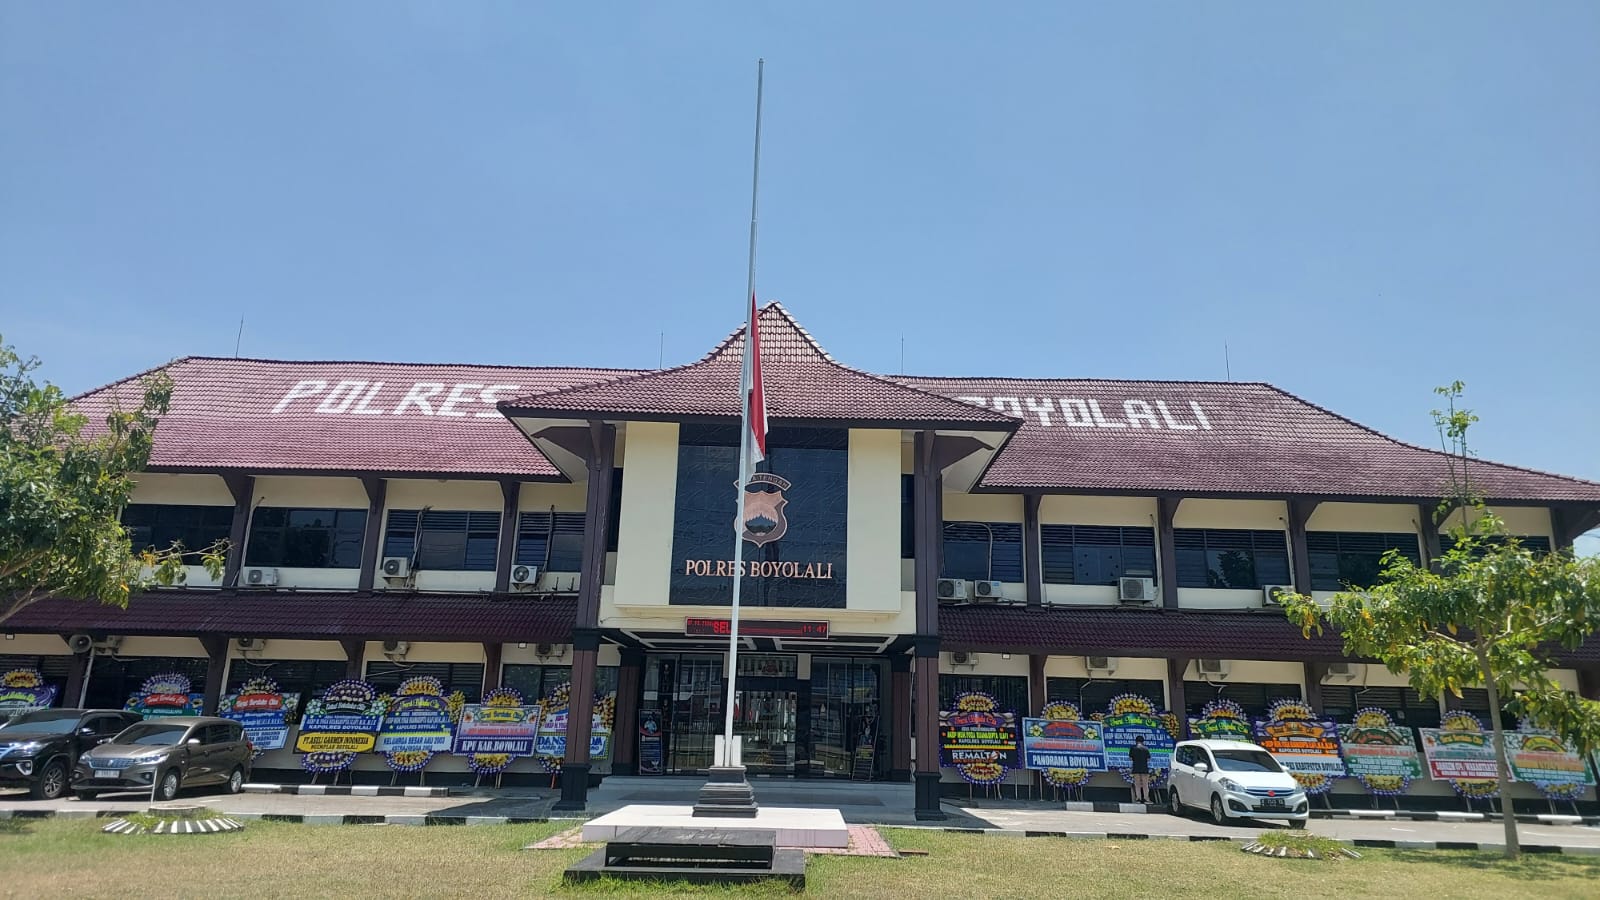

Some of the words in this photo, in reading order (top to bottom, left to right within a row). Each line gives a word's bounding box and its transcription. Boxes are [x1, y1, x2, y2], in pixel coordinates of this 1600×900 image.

[271, 379, 521, 418] POLRES
[685, 559, 746, 577] POLRES
[750, 561, 833, 579] BOYOLALI
[1032, 754, 1069, 767] PANORAMA
[1068, 755, 1100, 768] BOYOLALI
